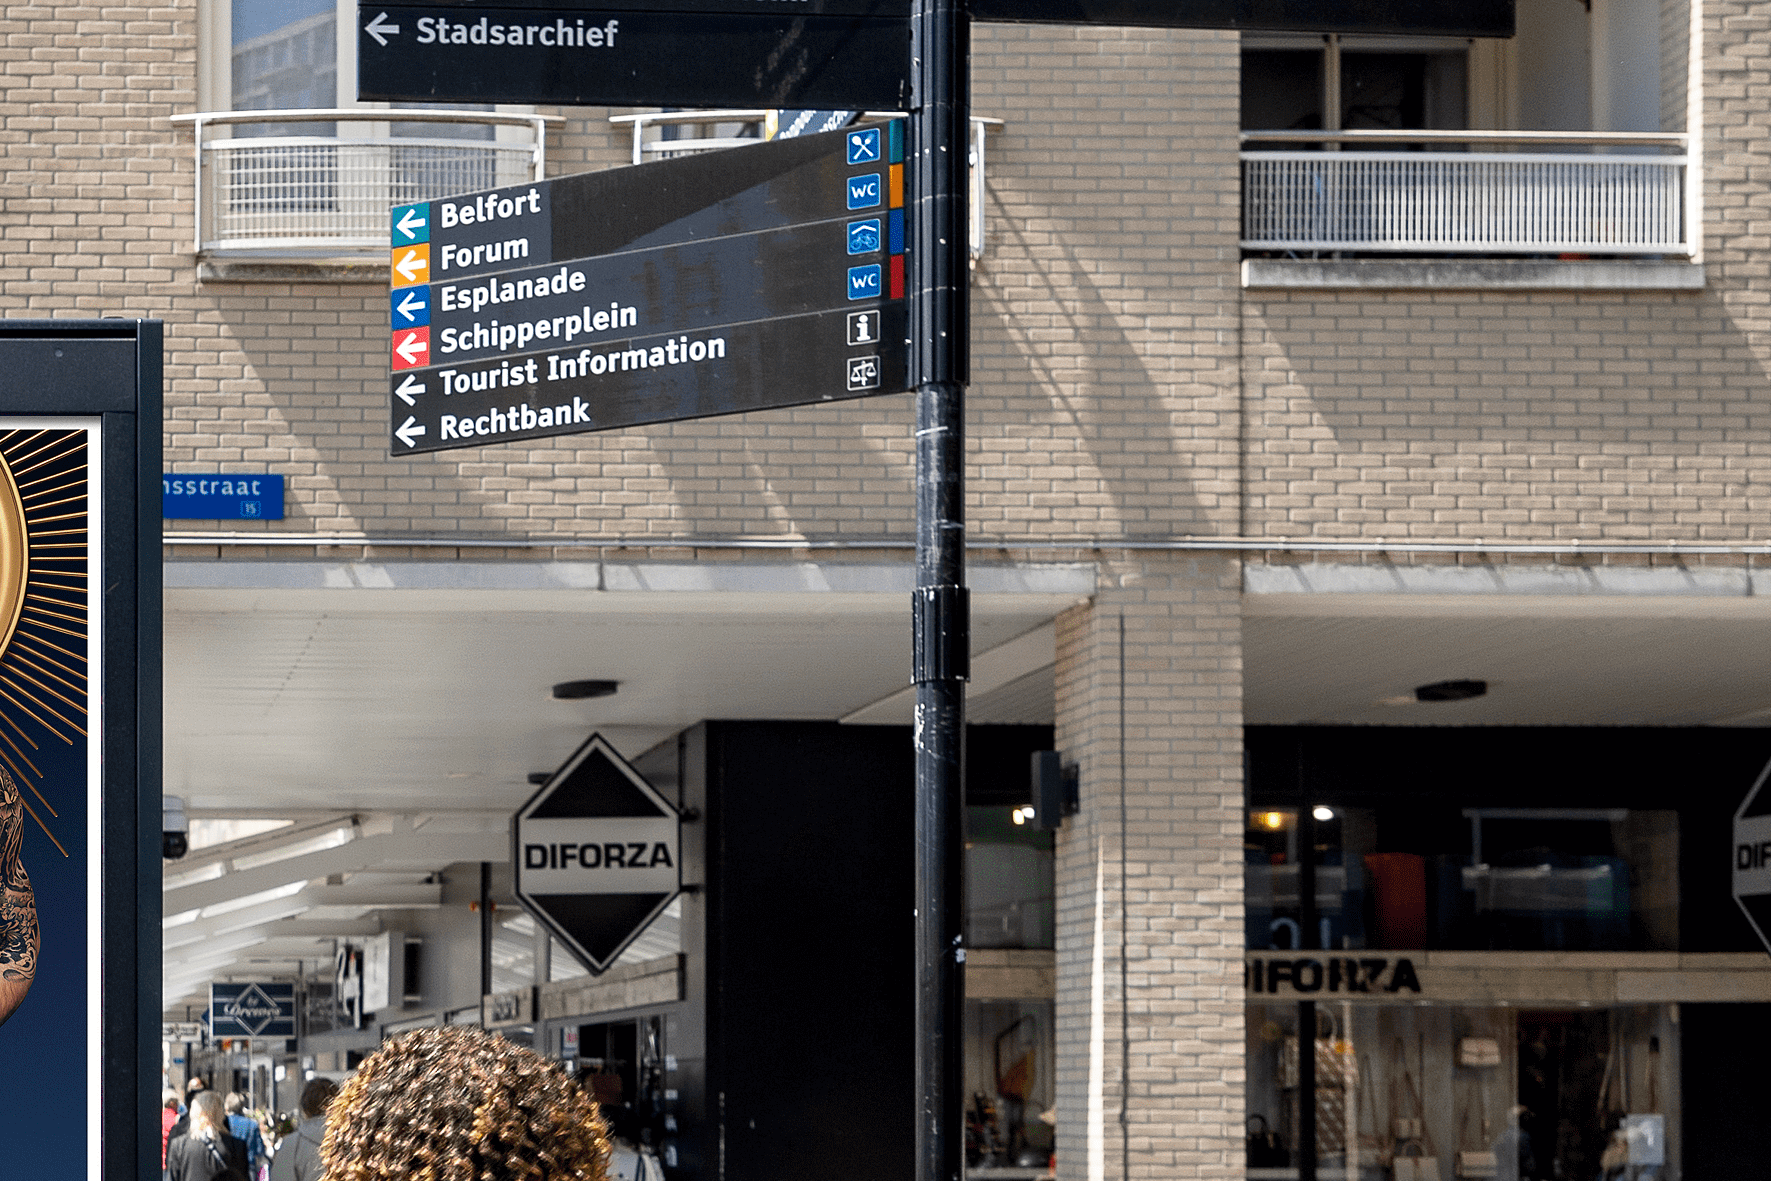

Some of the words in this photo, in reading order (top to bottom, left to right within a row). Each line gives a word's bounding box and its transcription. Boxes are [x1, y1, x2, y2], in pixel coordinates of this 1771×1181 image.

[416, 18, 619, 48] Stadsarchief
[440, 188, 541, 230] Belfort
[851, 183, 877, 199] WC
[440, 236, 529, 270] Forum
[440, 266, 586, 313] Esplanade
[851, 273, 877, 290] WC
[439, 302, 638, 355] Schipperplein
[439, 355, 538, 396] Tourist
[547, 335, 726, 383] Information
[439, 397, 591, 441] Rechtbank
[524, 842, 674, 871] DIFORZA
[1245, 957, 1422, 993] IFORZA
